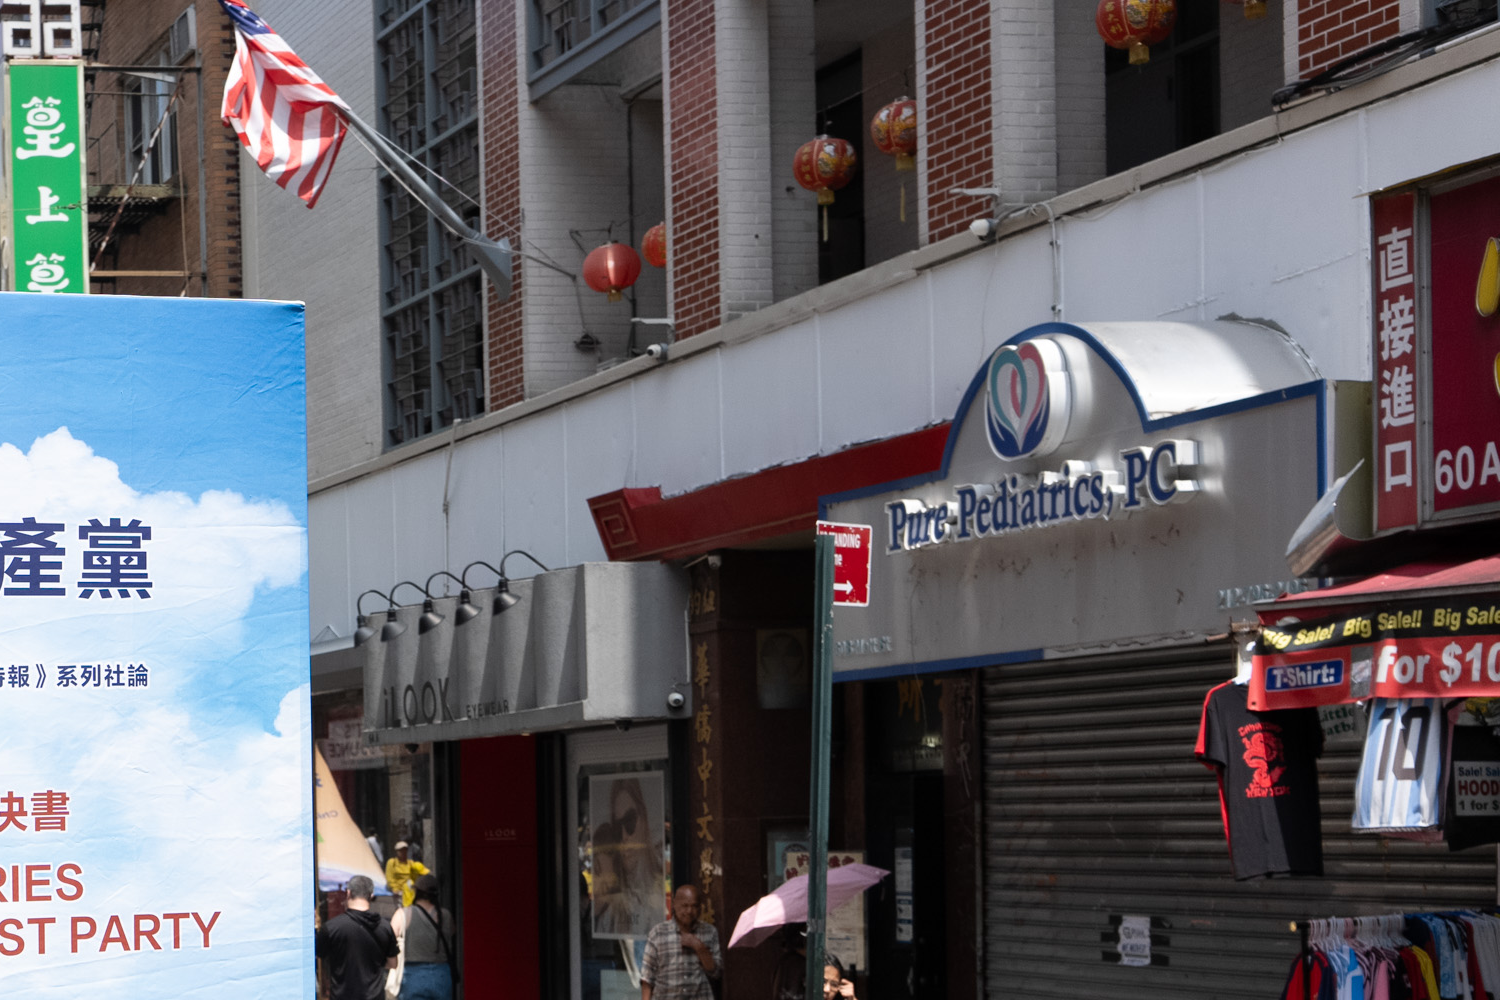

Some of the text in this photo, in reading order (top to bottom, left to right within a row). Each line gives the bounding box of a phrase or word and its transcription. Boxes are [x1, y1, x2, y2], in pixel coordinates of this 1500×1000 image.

[1378, 226, 1415, 493] 直接進口
[888, 441, 1198, 551] Pure Pediatrics, PC
[1263, 629, 1292, 649] Big
[1294, 623, 1336, 646] Sale!
[1343, 616, 1372, 638] Big
[1378, 609, 1422, 631] Sale!!
[1433, 608, 1461, 631] Big
[1272, 663, 1335, 688] T-Shirt:
[1376, 644, 1430, 684] for
[383, 677, 455, 729] iLOOK
[466, 699, 510, 719] EYEWEAR
[1377, 705, 1432, 782] 10
[1458, 767, 1482, 777] Sale!
[1458, 800, 1465, 811] 1
[1470, 800, 1488, 811] for
[69, 911, 221, 953] PARTY
